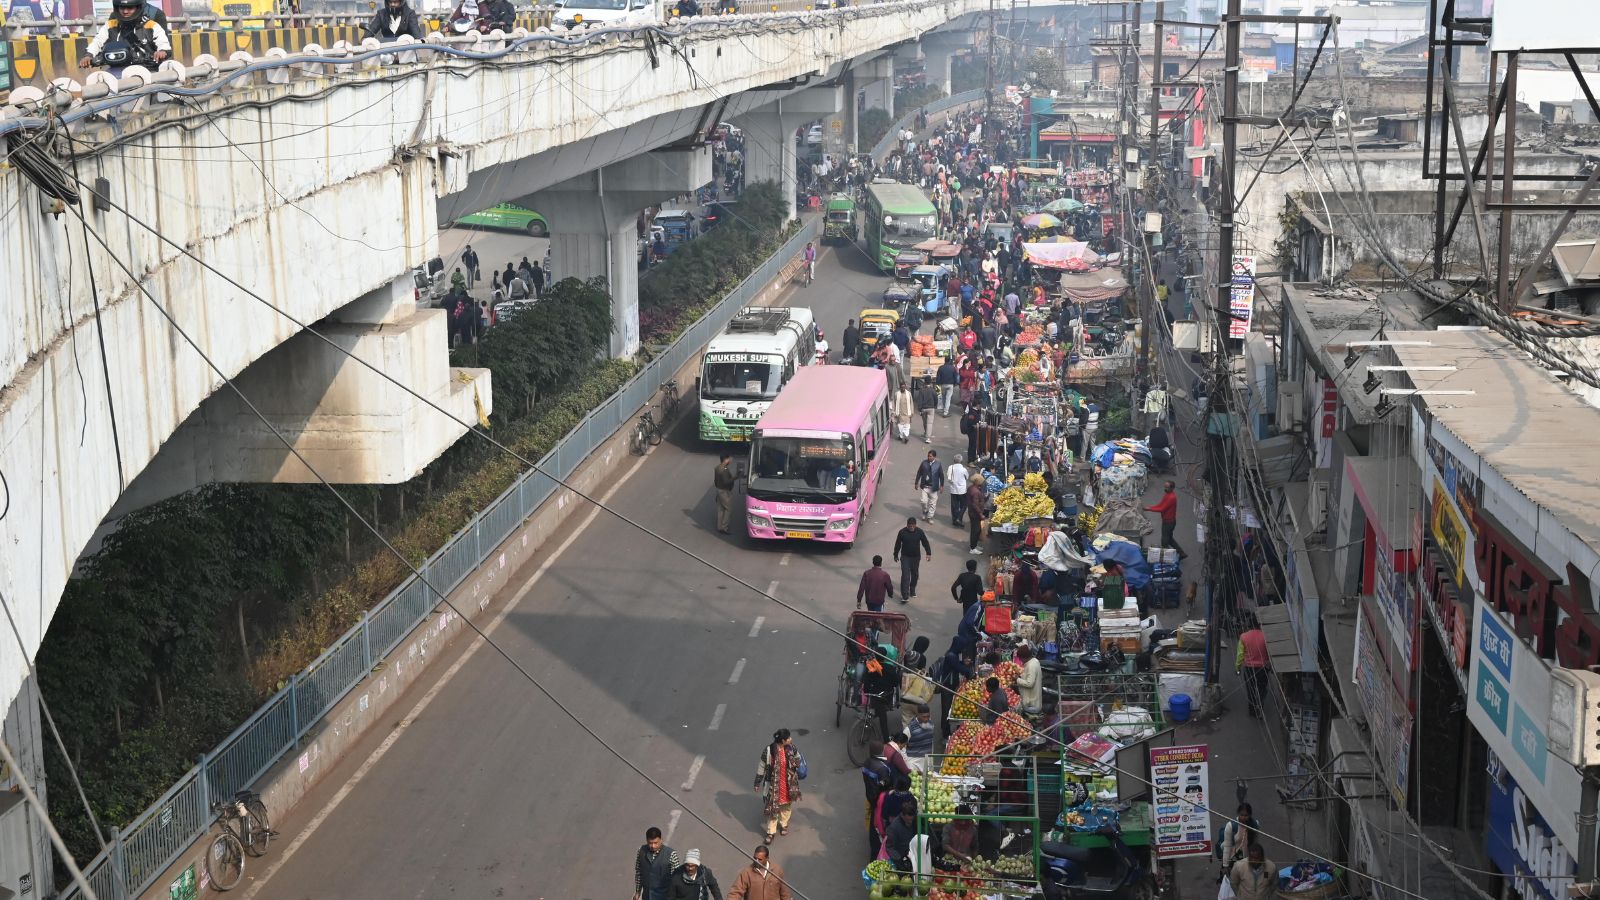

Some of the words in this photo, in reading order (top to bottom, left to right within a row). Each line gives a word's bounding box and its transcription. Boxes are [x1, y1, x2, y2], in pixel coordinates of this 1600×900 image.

[710, 354, 748, 362] MUKESH
[776, 503, 797, 513] बिहार
[798, 504, 826, 514] सरकार
[1483, 622, 1498, 653] शुद्ध
[1500, 639, 1510, 668] घी
[1483, 679, 1502, 715] क्रीम
[1520, 725, 1538, 760] दही
[1511, 786, 1576, 900] Sudh
